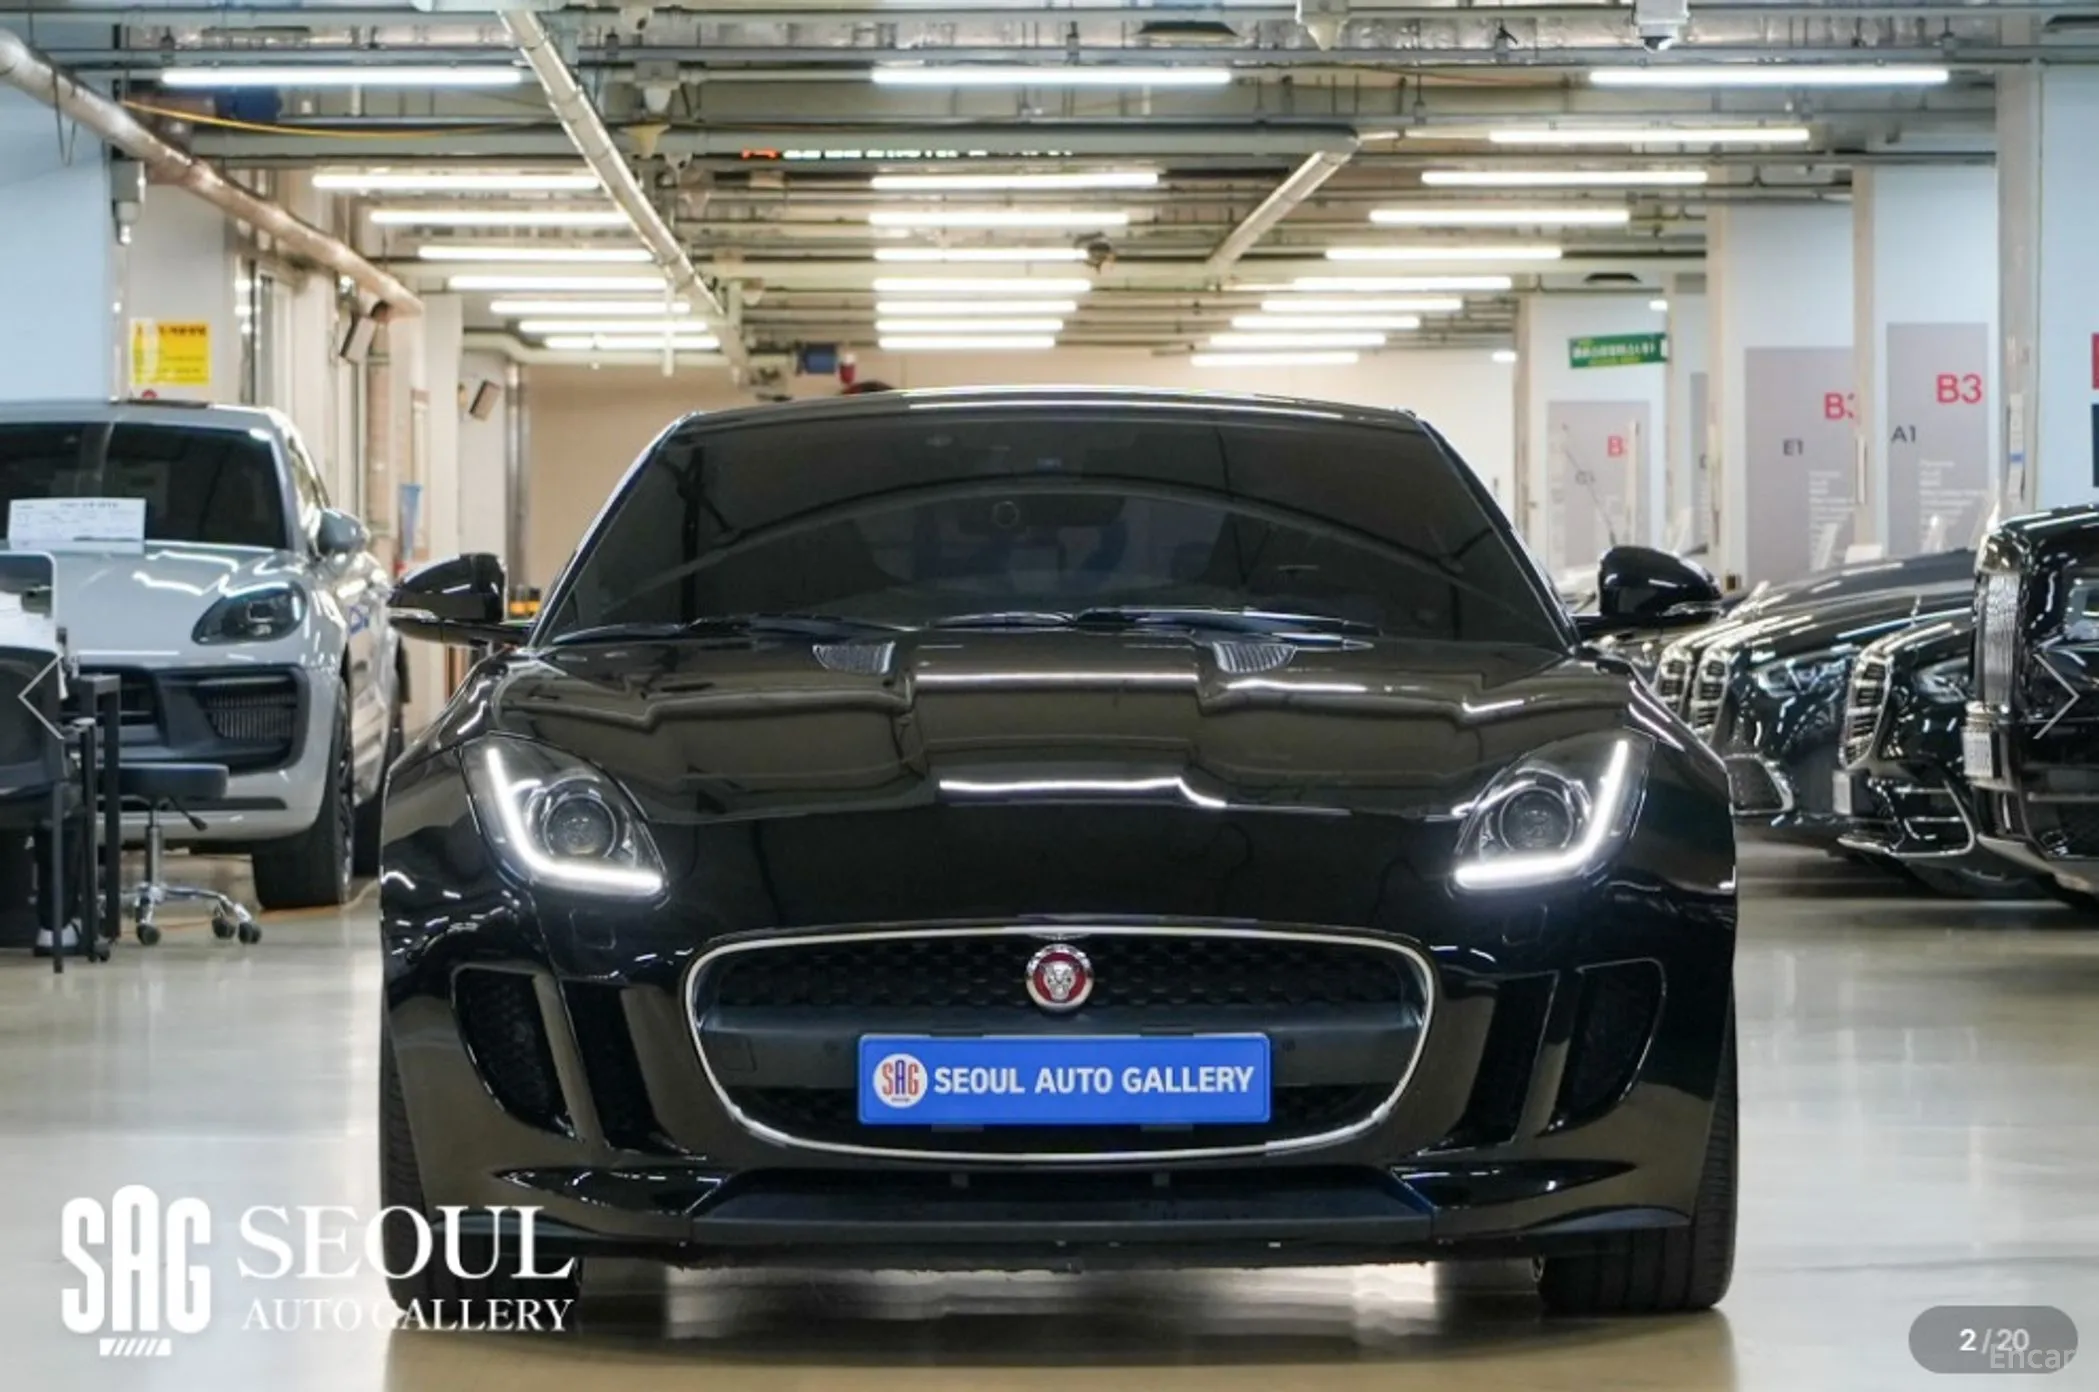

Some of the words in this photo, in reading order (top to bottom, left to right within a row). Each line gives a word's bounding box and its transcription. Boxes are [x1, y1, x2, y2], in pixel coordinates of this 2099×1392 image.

[1936, 373, 1982, 403] B3
[1891, 425, 1916, 443] A1
[1783, 439, 1804, 456] E1
[882, 1060, 920, 1096] SAG
[934, 1067, 1025, 1094] SEOUL
[1035, 1067, 1113, 1094] AUTO
[1122, 1066, 1254, 1094] GALLERY
